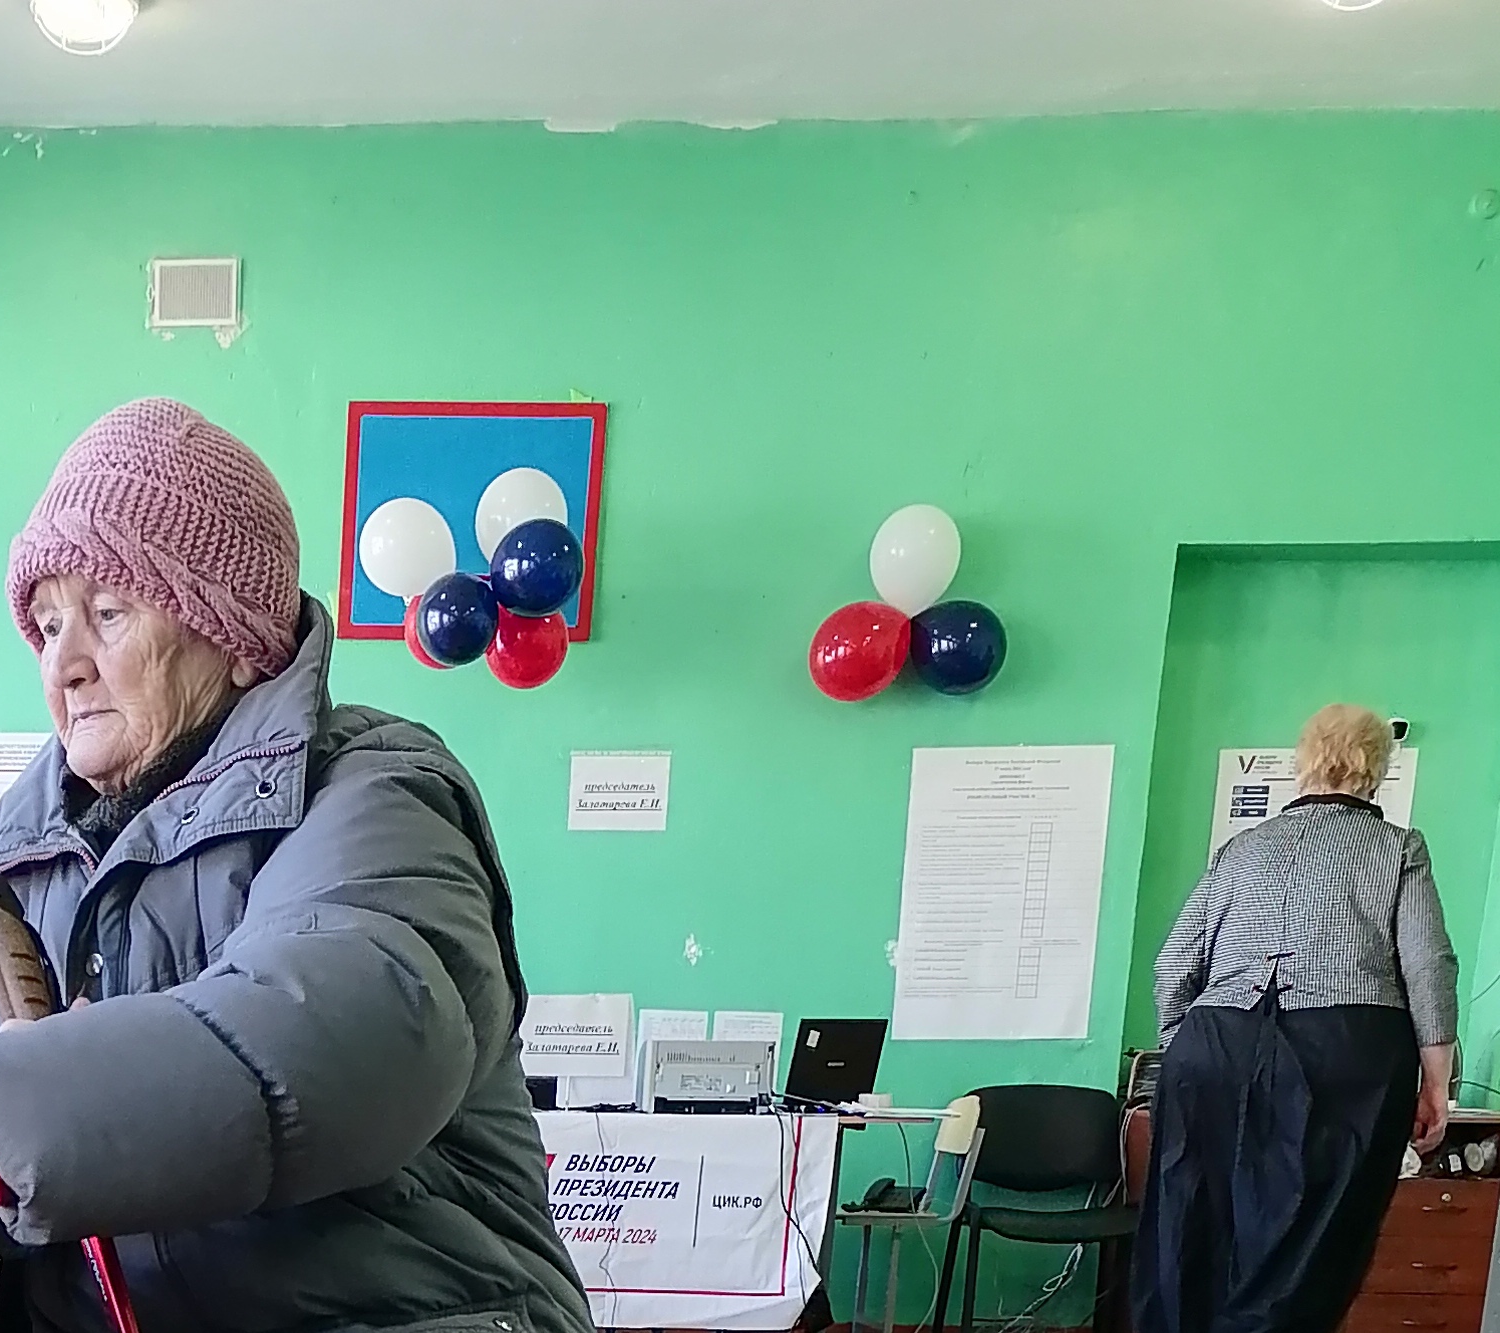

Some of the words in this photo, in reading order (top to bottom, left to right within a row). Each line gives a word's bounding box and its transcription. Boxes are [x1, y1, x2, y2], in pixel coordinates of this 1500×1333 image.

[584, 782, 656, 792] председатель
[534, 1023, 613, 1035] председатель
[565, 1154, 656, 1174] ВЫБОРЫ
[553, 1178, 680, 1201] ПРЕЗИДЕНТА
[712, 1195, 763, 1210] ЦИК.РФ
[572, 1227, 621, 1243] МАРТА
[622, 1228, 657, 1244] 2024
